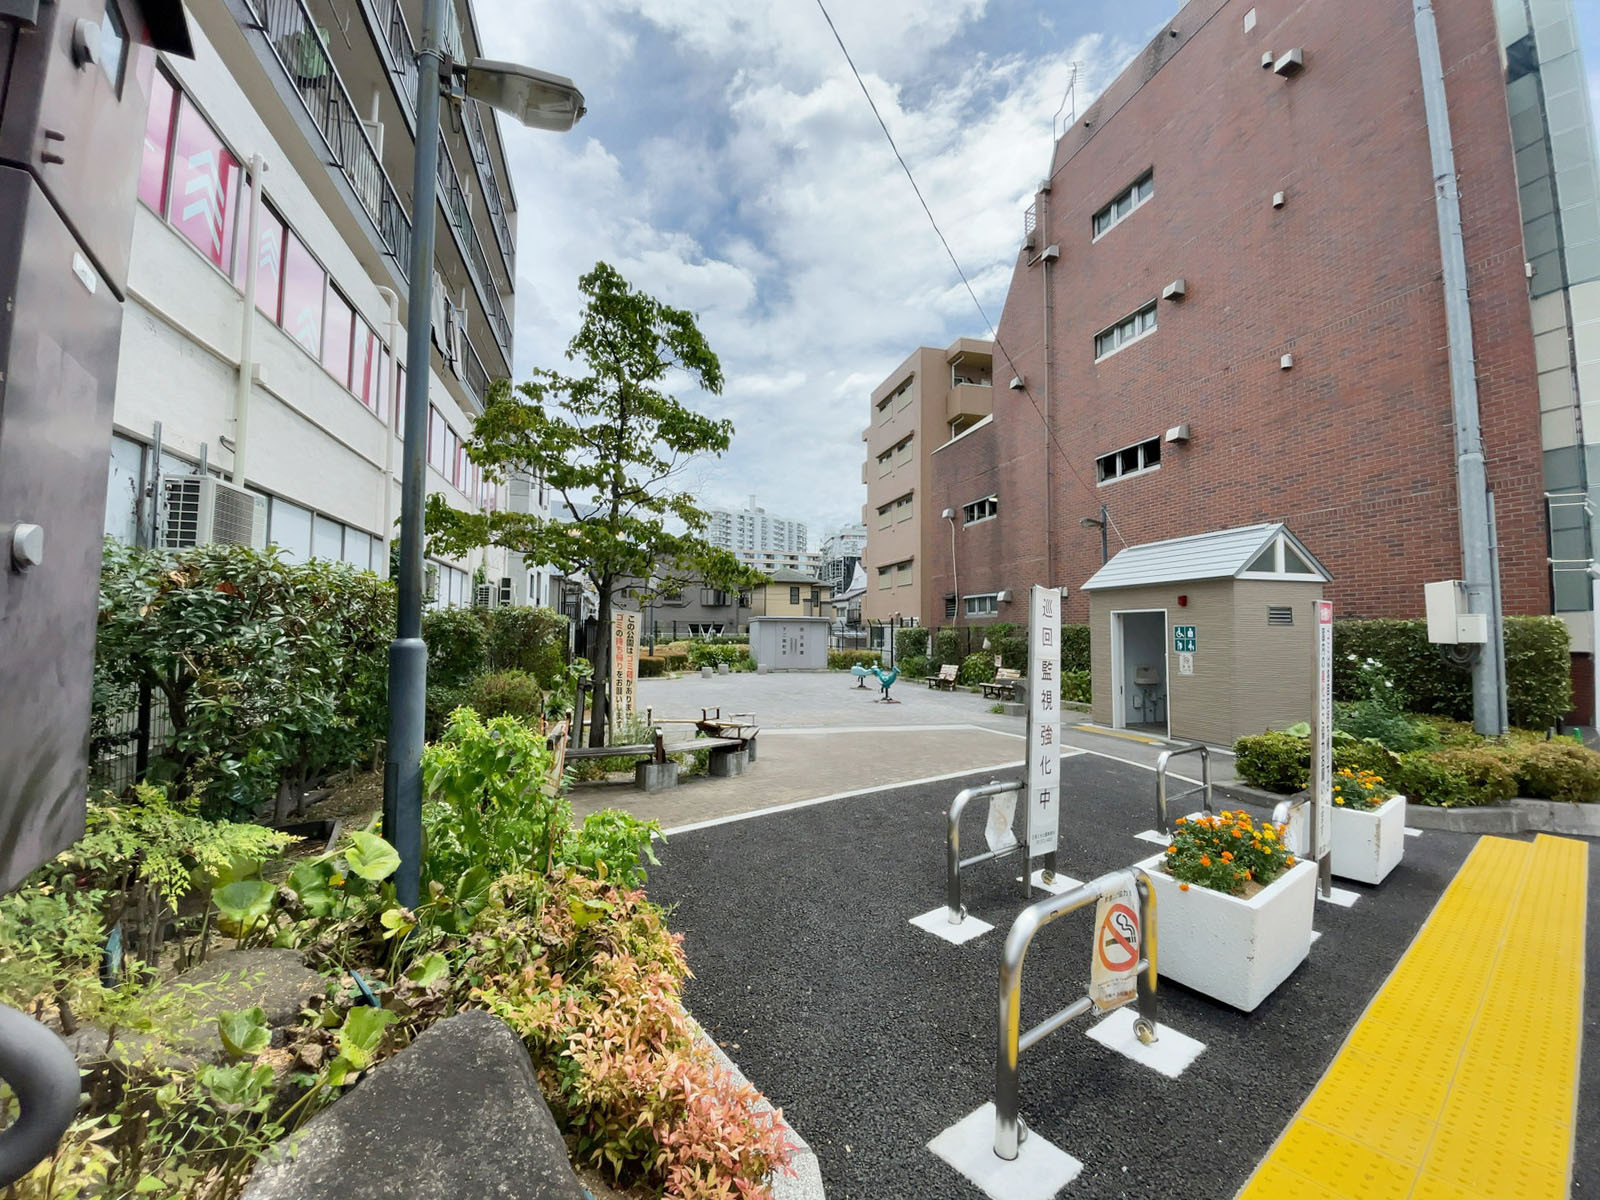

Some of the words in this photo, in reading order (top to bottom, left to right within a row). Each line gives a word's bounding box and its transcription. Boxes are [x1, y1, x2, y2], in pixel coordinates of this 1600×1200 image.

[1040, 598, 1053, 810] 巡回監視強化中
